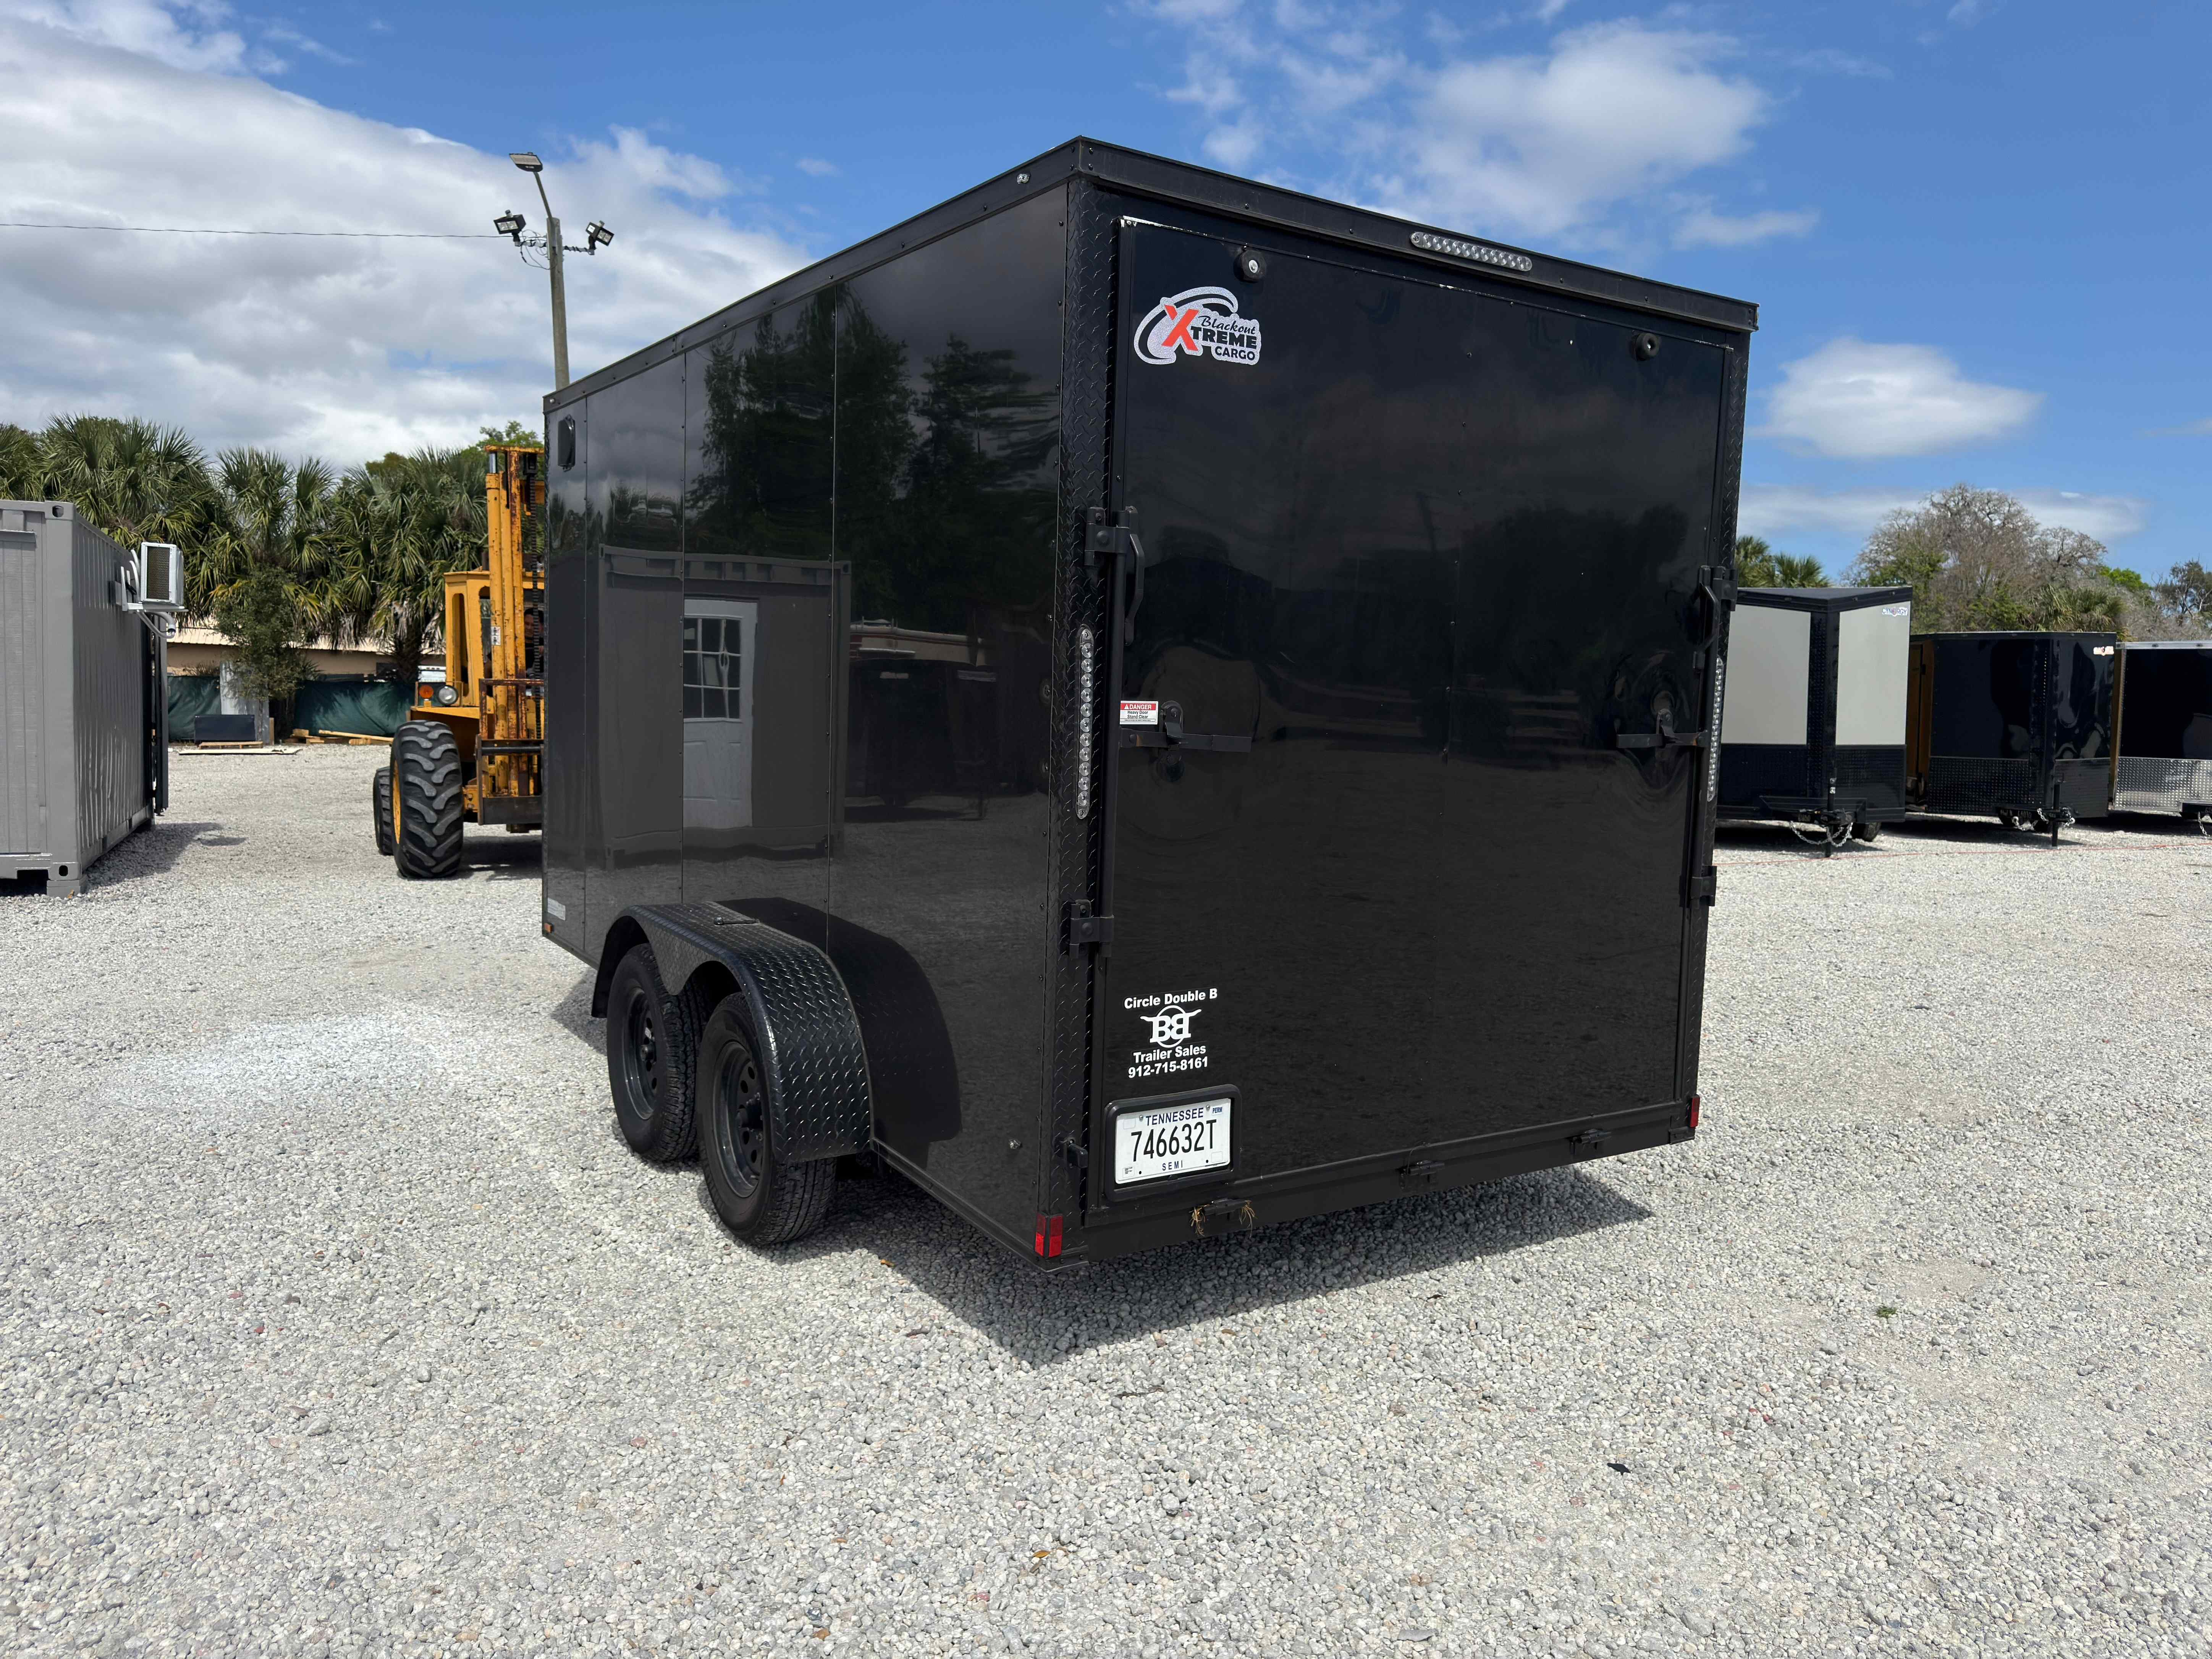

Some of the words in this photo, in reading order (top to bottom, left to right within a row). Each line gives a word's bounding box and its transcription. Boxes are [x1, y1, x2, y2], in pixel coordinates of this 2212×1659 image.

[1198, 315, 1256, 334] Blackout
[1215, 346, 1255, 361] CARGO
[1124, 995, 1161, 1009] Circle
[1164, 991, 1206, 1004] Double
[1209, 988, 1218, 999] B
[1133, 1049, 1172, 1063] Trailer
[1175, 1045, 1206, 1057] Sales
[1128, 1056, 1208, 1078] 912-715-8161
[1146, 1108, 1203, 1126] TENNESSEE
[1131, 1119, 1217, 1162] 746632T
[1162, 1160, 1183, 1171] SEMI
